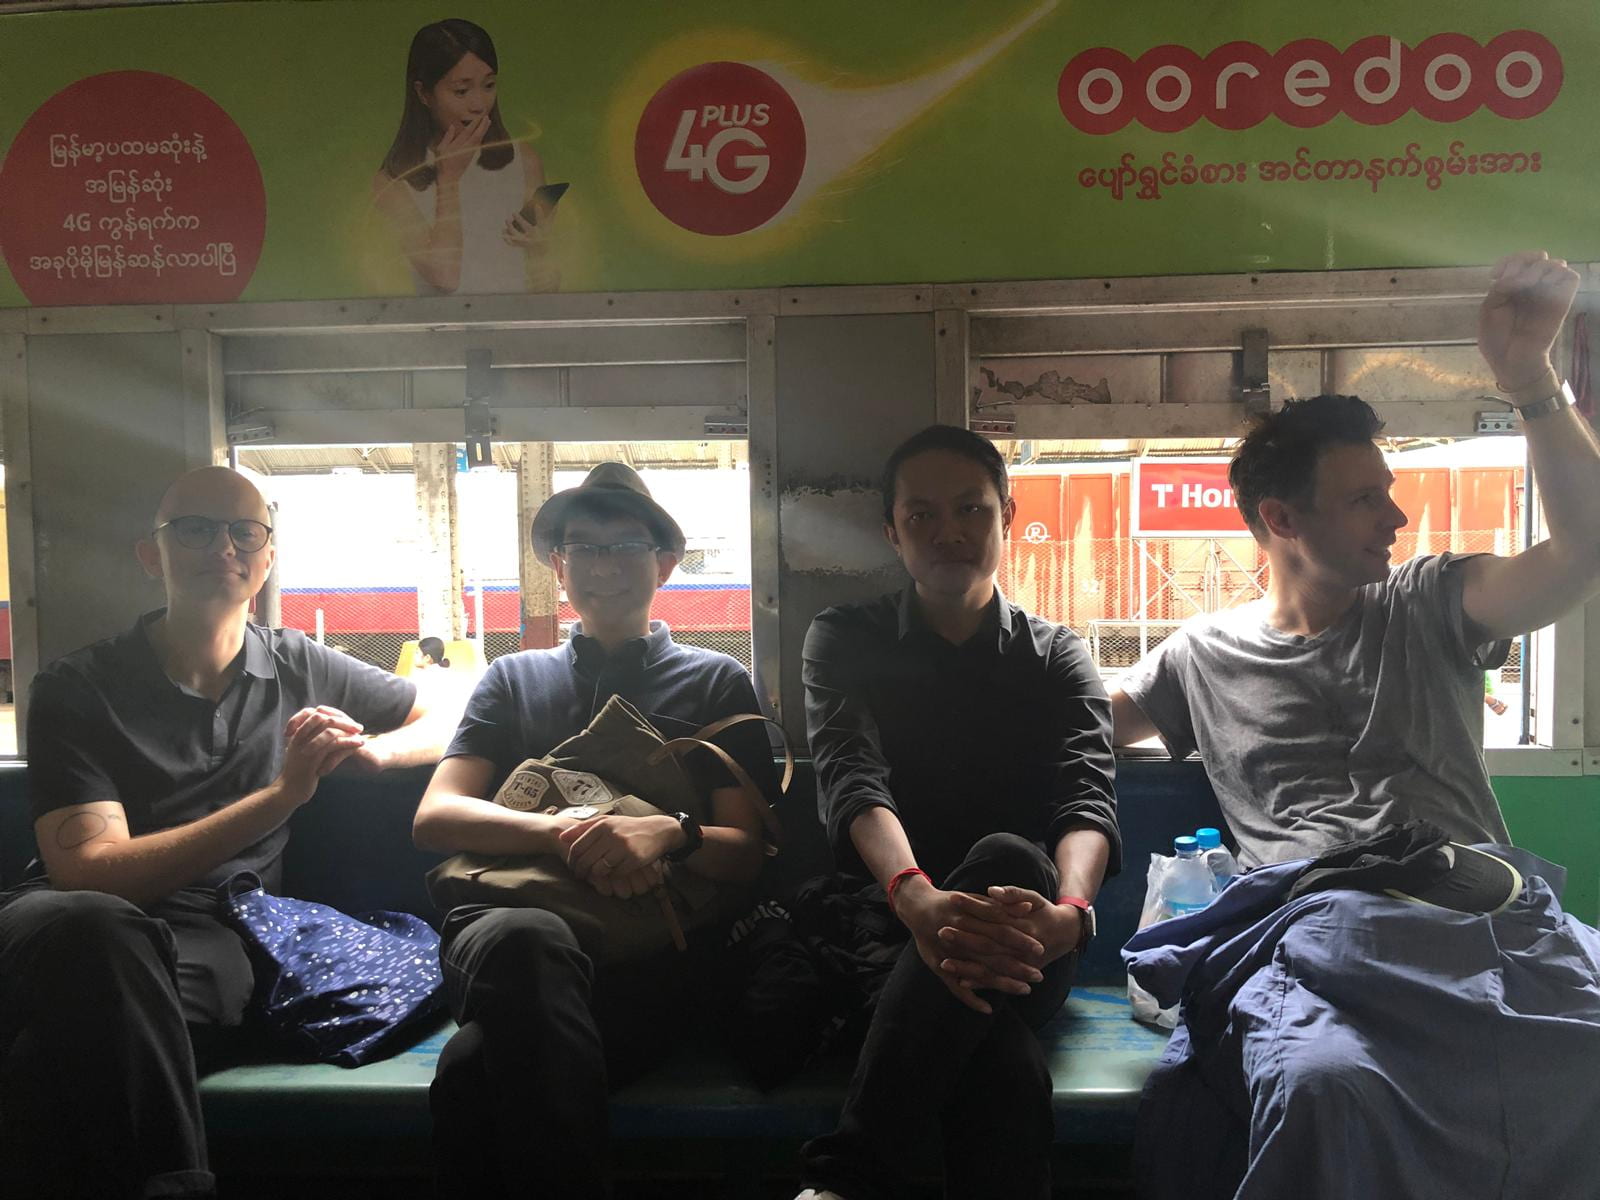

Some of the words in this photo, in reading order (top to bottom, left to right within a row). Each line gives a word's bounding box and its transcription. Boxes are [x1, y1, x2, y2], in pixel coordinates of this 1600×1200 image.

[1078, 37, 1543, 115] ooredoo
[701, 103, 770, 127] PLUS
[665, 109, 770, 195] 4G
[63, 214, 91, 231] 4G
[1151, 484, 1174, 509] T
[513, 781, 540, 799] T-65
[572, 779, 593, 797] 77
